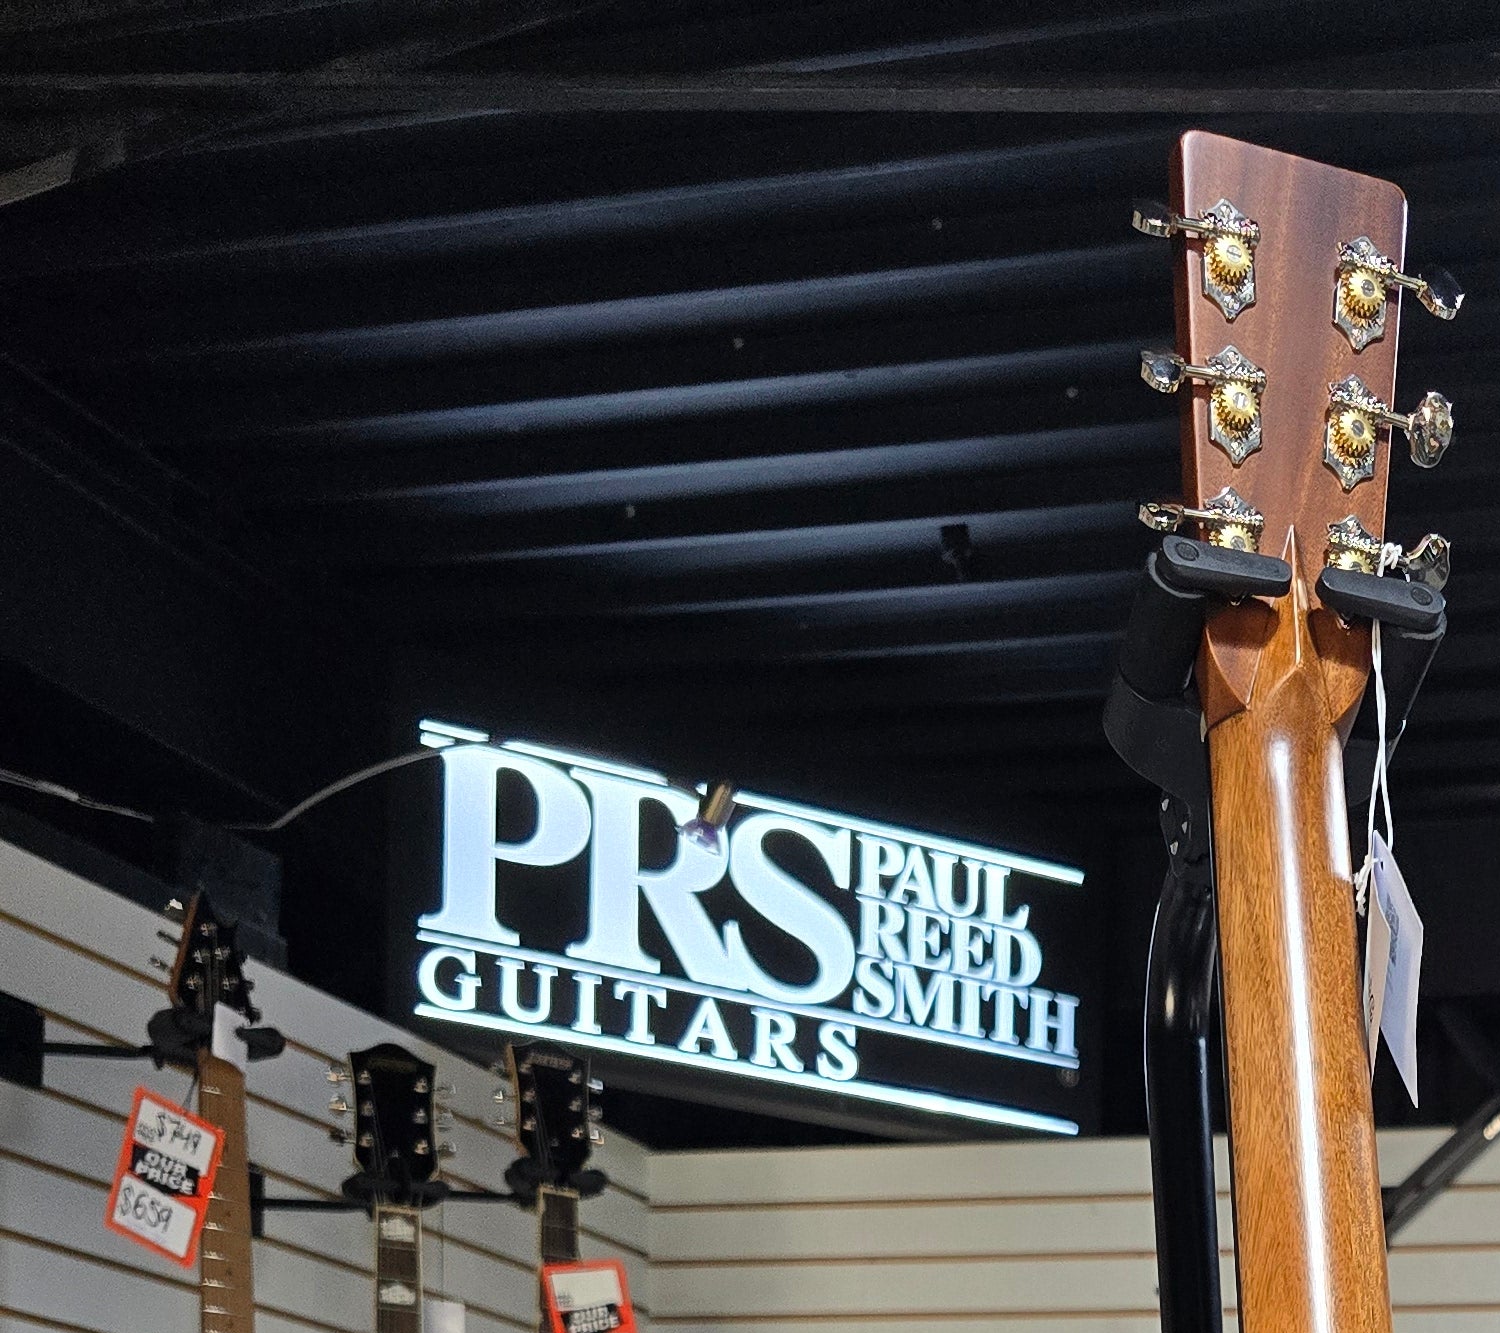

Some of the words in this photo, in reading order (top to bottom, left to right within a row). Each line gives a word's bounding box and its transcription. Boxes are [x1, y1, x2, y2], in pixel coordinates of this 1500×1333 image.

[418, 742, 856, 1005] PRS
[857, 832, 1030, 930] PAUL
[856, 897, 1043, 987] REED
[417, 946, 861, 1081] GUITARS
[853, 954, 1080, 1059] SMITH
[133, 1159, 196, 1195] PRICE
[144, 1150, 188, 1178] OUR
[572, 1306, 608, 1323] OUR
